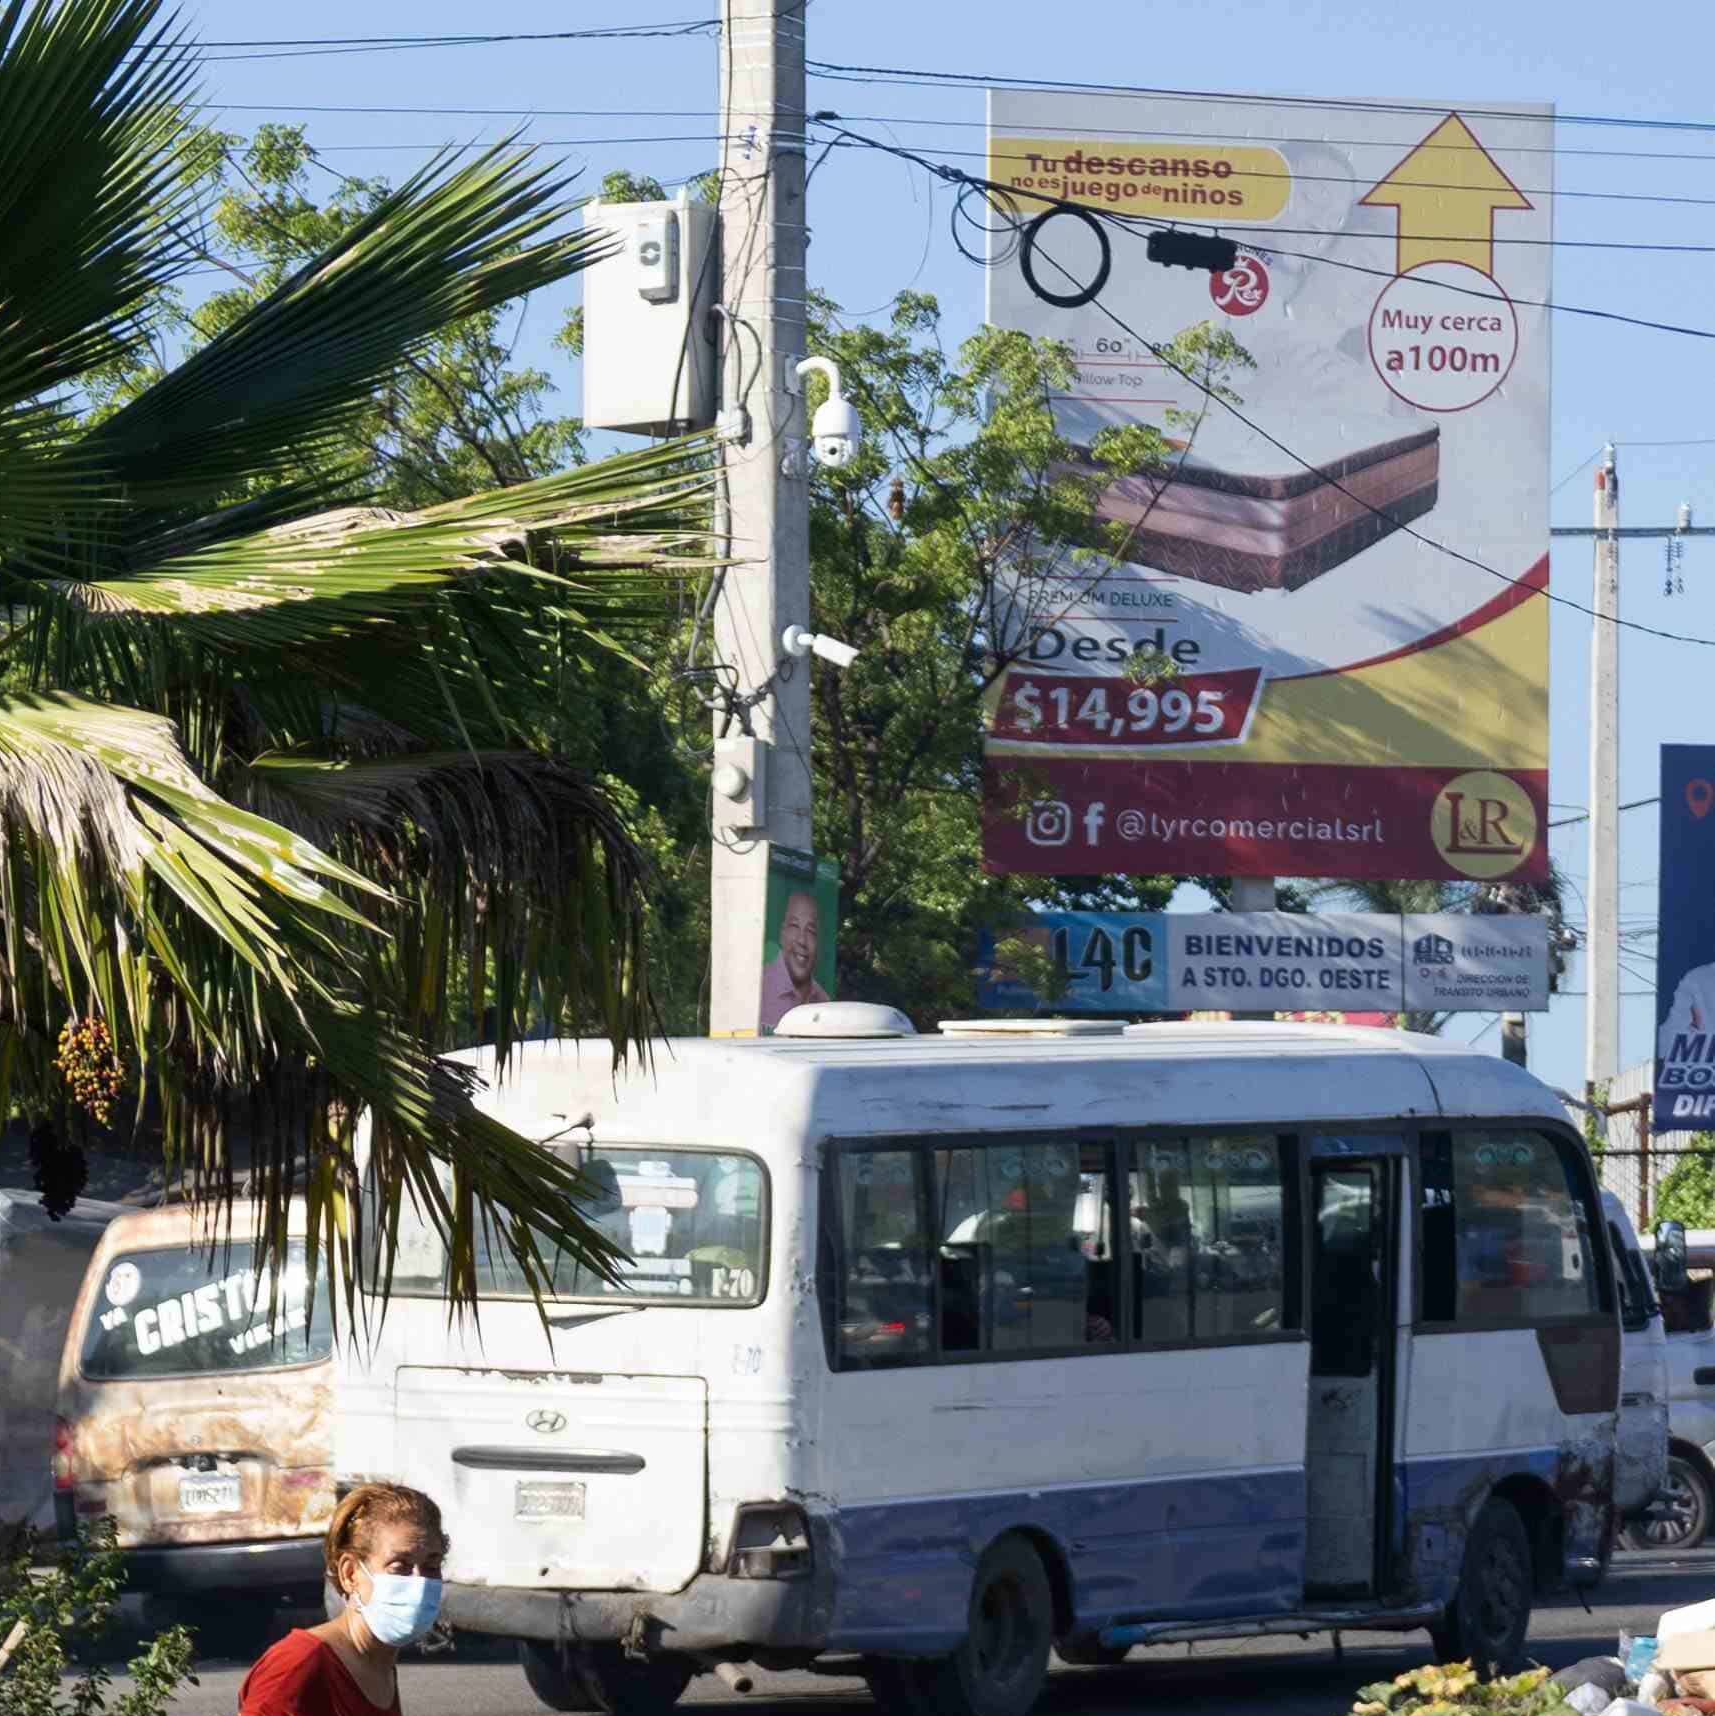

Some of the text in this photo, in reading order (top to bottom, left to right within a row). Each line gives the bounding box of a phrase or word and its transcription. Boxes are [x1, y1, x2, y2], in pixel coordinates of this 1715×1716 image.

[1026, 150, 1233, 179] Tu descanso
[1011, 175, 1244, 206] no es juego de niños
[1381, 309, 1502, 334] Muy cerca
[1117, 374, 1144, 388] Top
[1110, 592, 1174, 606] DELUXE
[1029, 627, 1202, 665] Desde
[1015, 681, 1226, 737] $14,995
[1116, 808, 1384, 844] @lyrcomercialsrl
[1185, 934, 1385, 959] BIENVENIDOS
[1182, 967, 1391, 990] A STO. DGO. OESTE
[1662, 1066, 1715, 1086] BO
